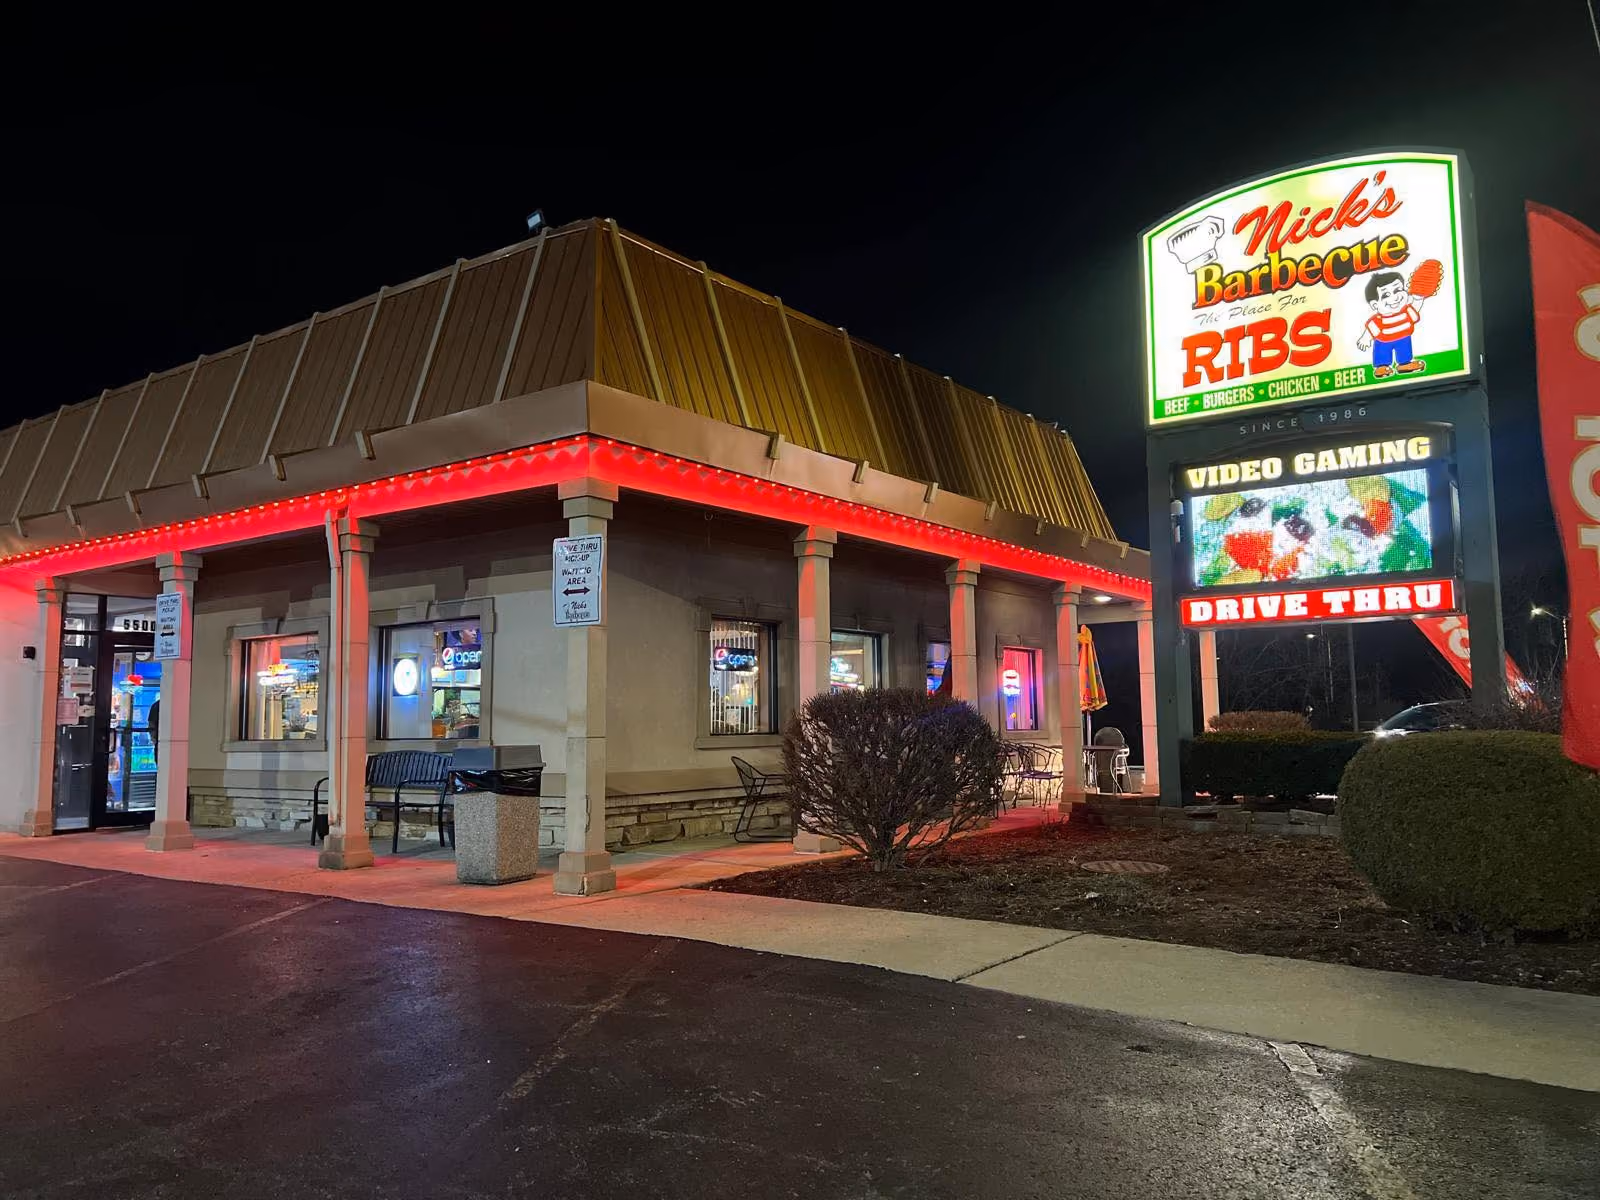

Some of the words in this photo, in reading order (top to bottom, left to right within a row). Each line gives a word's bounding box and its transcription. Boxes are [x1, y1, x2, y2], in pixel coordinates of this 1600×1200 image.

[1232, 170, 1403, 256] Nick's
[1192, 233, 1410, 310] Barbecue
[1194, 312, 1222, 326] The
[1228, 303, 1272, 320] Place
[1278, 294, 1307, 311] For
[1181, 308, 1333, 388] RIBS
[1164, 397, 1190, 416] BEEF
[1203, 386, 1255, 409] BURGERS
[1267, 375, 1320, 400] CHICKEN
[1334, 368, 1366, 388] BEER
[1239, 418, 1298, 435] SINCE
[1318, 407, 1367, 423] 1986
[1185, 456, 1283, 489] VIDEO
[1293, 436, 1432, 476] GAMING
[567, 577, 586, 586] AREA
[1190, 592, 1308, 622] DRIVE
[1322, 583, 1442, 614] THRU
[123, 619, 156, 632] 5500
